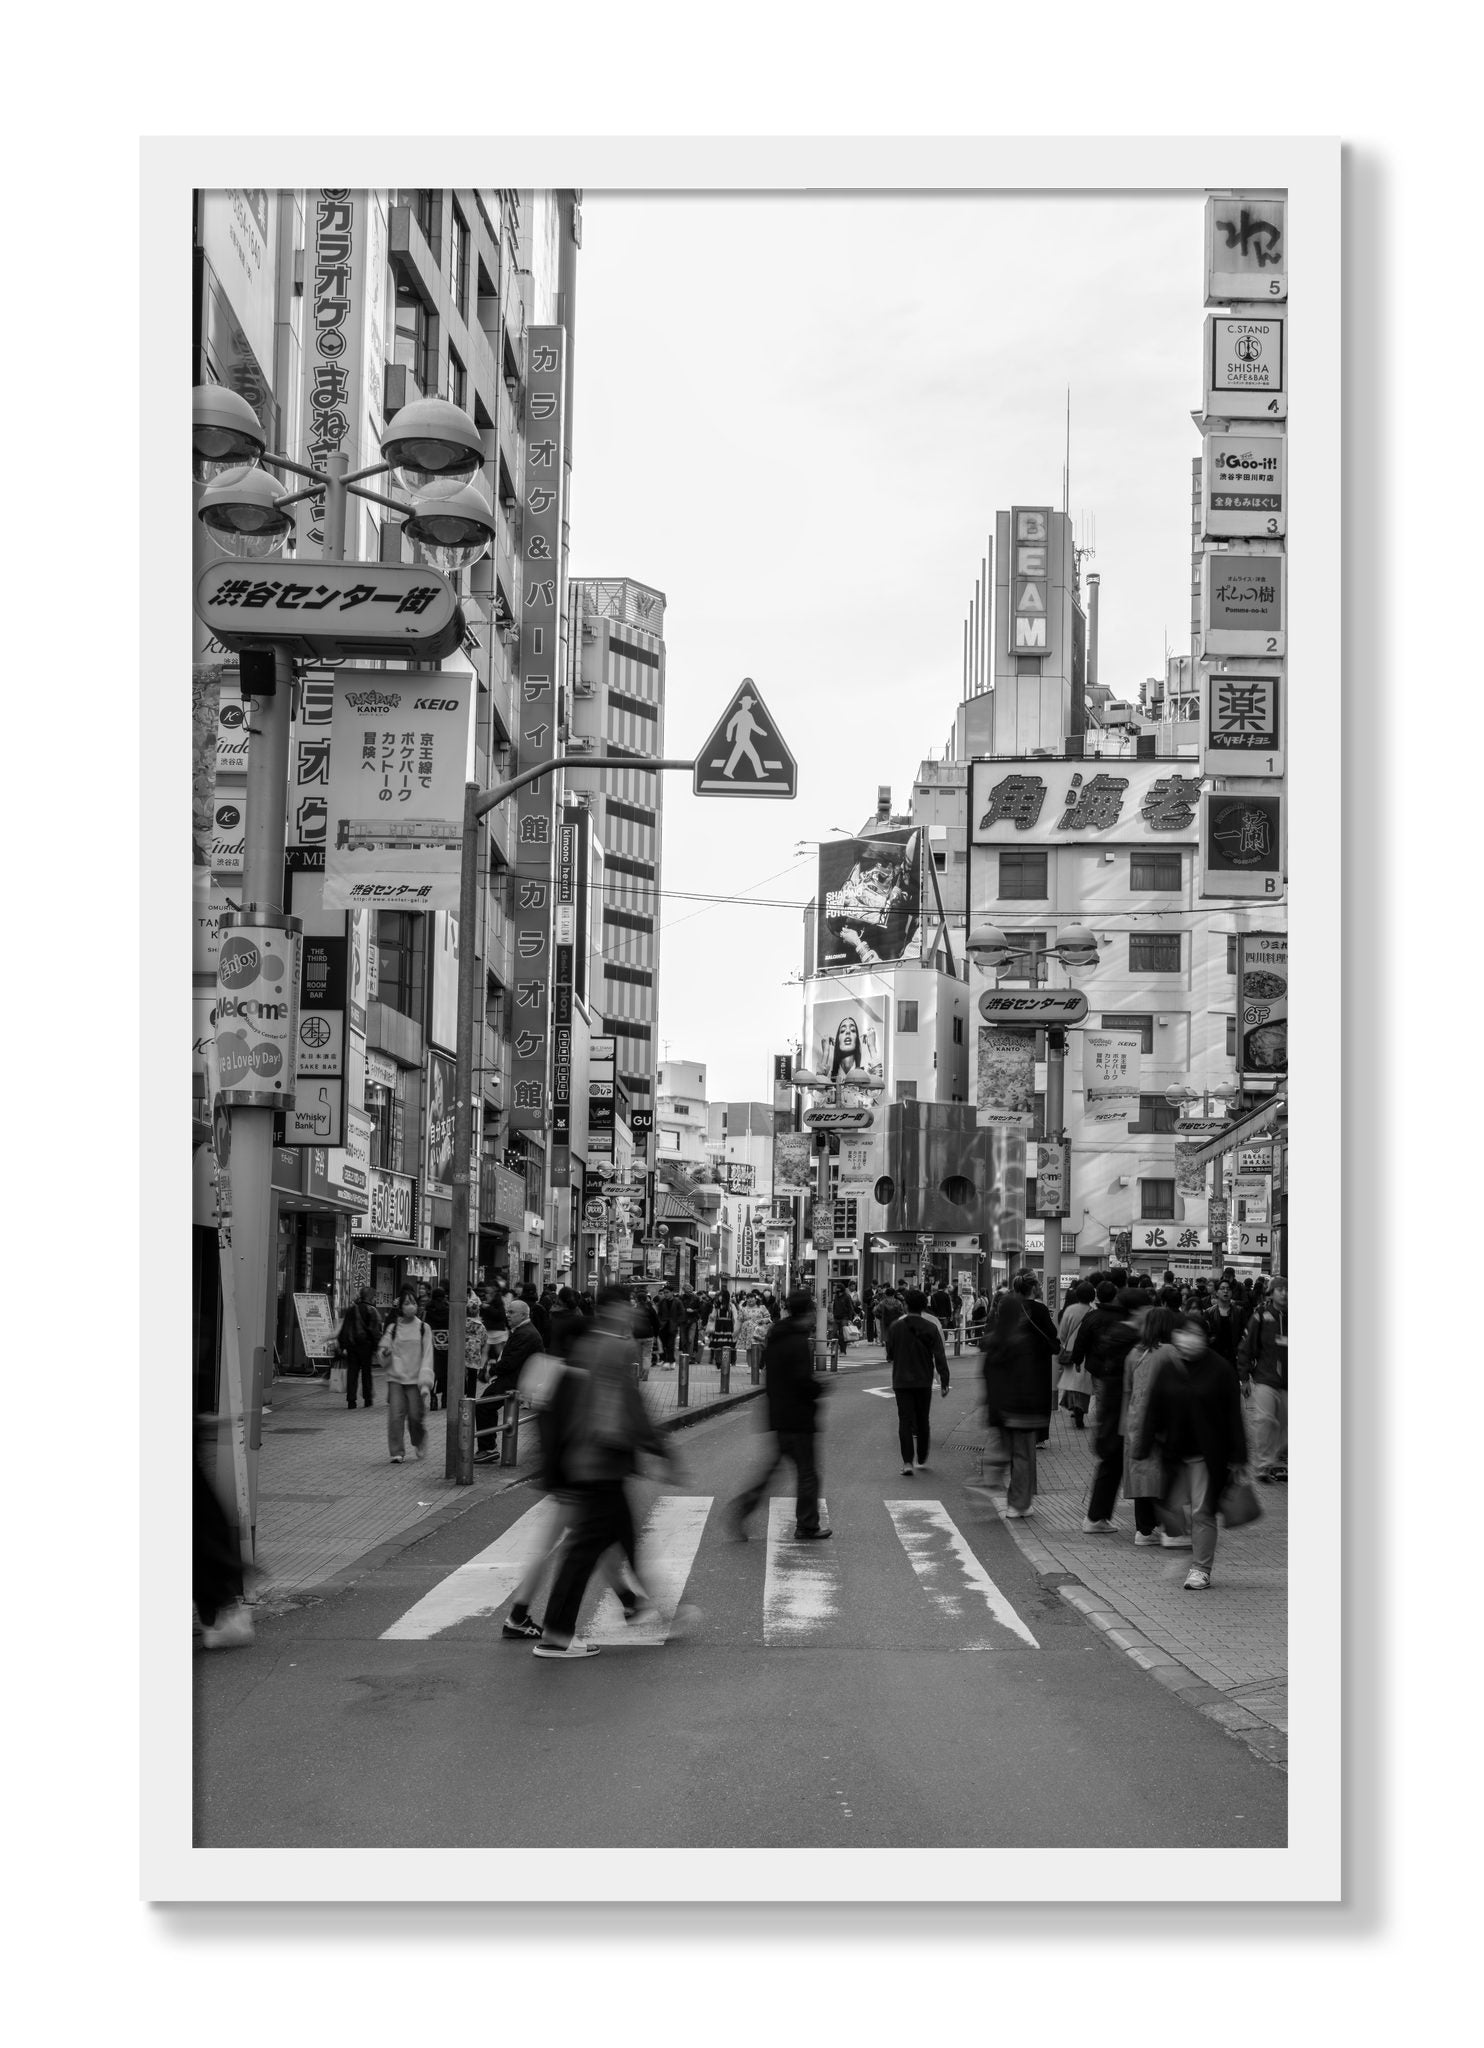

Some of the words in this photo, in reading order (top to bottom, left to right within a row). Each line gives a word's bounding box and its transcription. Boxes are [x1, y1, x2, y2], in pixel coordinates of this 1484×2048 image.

[314, 200, 353, 332] カラオケ
[1269, 280, 1281, 296] 5
[1227, 325, 1270, 334] C.STAND
[1227, 363, 1270, 373] SHISHA
[1227, 373, 1269, 381] CAFE&BAR
[1267, 399, 1279, 413] 4
[1226, 454, 1278, 470] Goo-it!
[1219, 473, 1275, 482] 渋谷宇田川町店
[1214, 496, 1278, 508] 全身もみほぐし
[1267, 518, 1278, 534] 3
[1016, 512, 1047, 649] BEAM
[207, 579, 442, 615] 渋谷センター街
[1215, 584, 1275, 603] ポムの樹
[1266, 637, 1277, 652] 2
[413, 698, 459, 711] KEIO
[1219, 683, 1266, 731] 薬
[1213, 733, 1271, 746] マツモトキヨシ
[361, 731, 376, 772] 冒険へ
[220, 758, 244, 766] 渋谷店
[379, 731, 395, 802] カントーの
[418, 733, 434, 788] 京王線で
[1265, 757, 1274, 773] 1
[979, 774, 1200, 831] 角海老
[1213, 809, 1270, 856] 一蘭
[562, 829, 571, 863] kimono
[216, 858, 240, 867] 渋谷店
[350, 884, 433, 896] 渋谷センター街
[1265, 878, 1276, 893] B
[219, 950, 257, 981] Enjoy
[513, 881, 547, 1110] カラオケ館
[217, 996, 289, 1020] Welcome
[986, 998, 1082, 1010] 渋谷センター街
[1244, 1005, 1271, 1025] 6F
[232, 1051, 261, 1069] Lovely
[262, 1051, 281, 1065] Day!
[295, 1121, 313, 1129] Bank
[296, 1113, 327, 1123] Whisky
[633, 1116, 652, 1126] GU
[807, 1113, 865, 1122] 渋谷センター街
[1145, 1228, 1200, 1248] 兆楽
